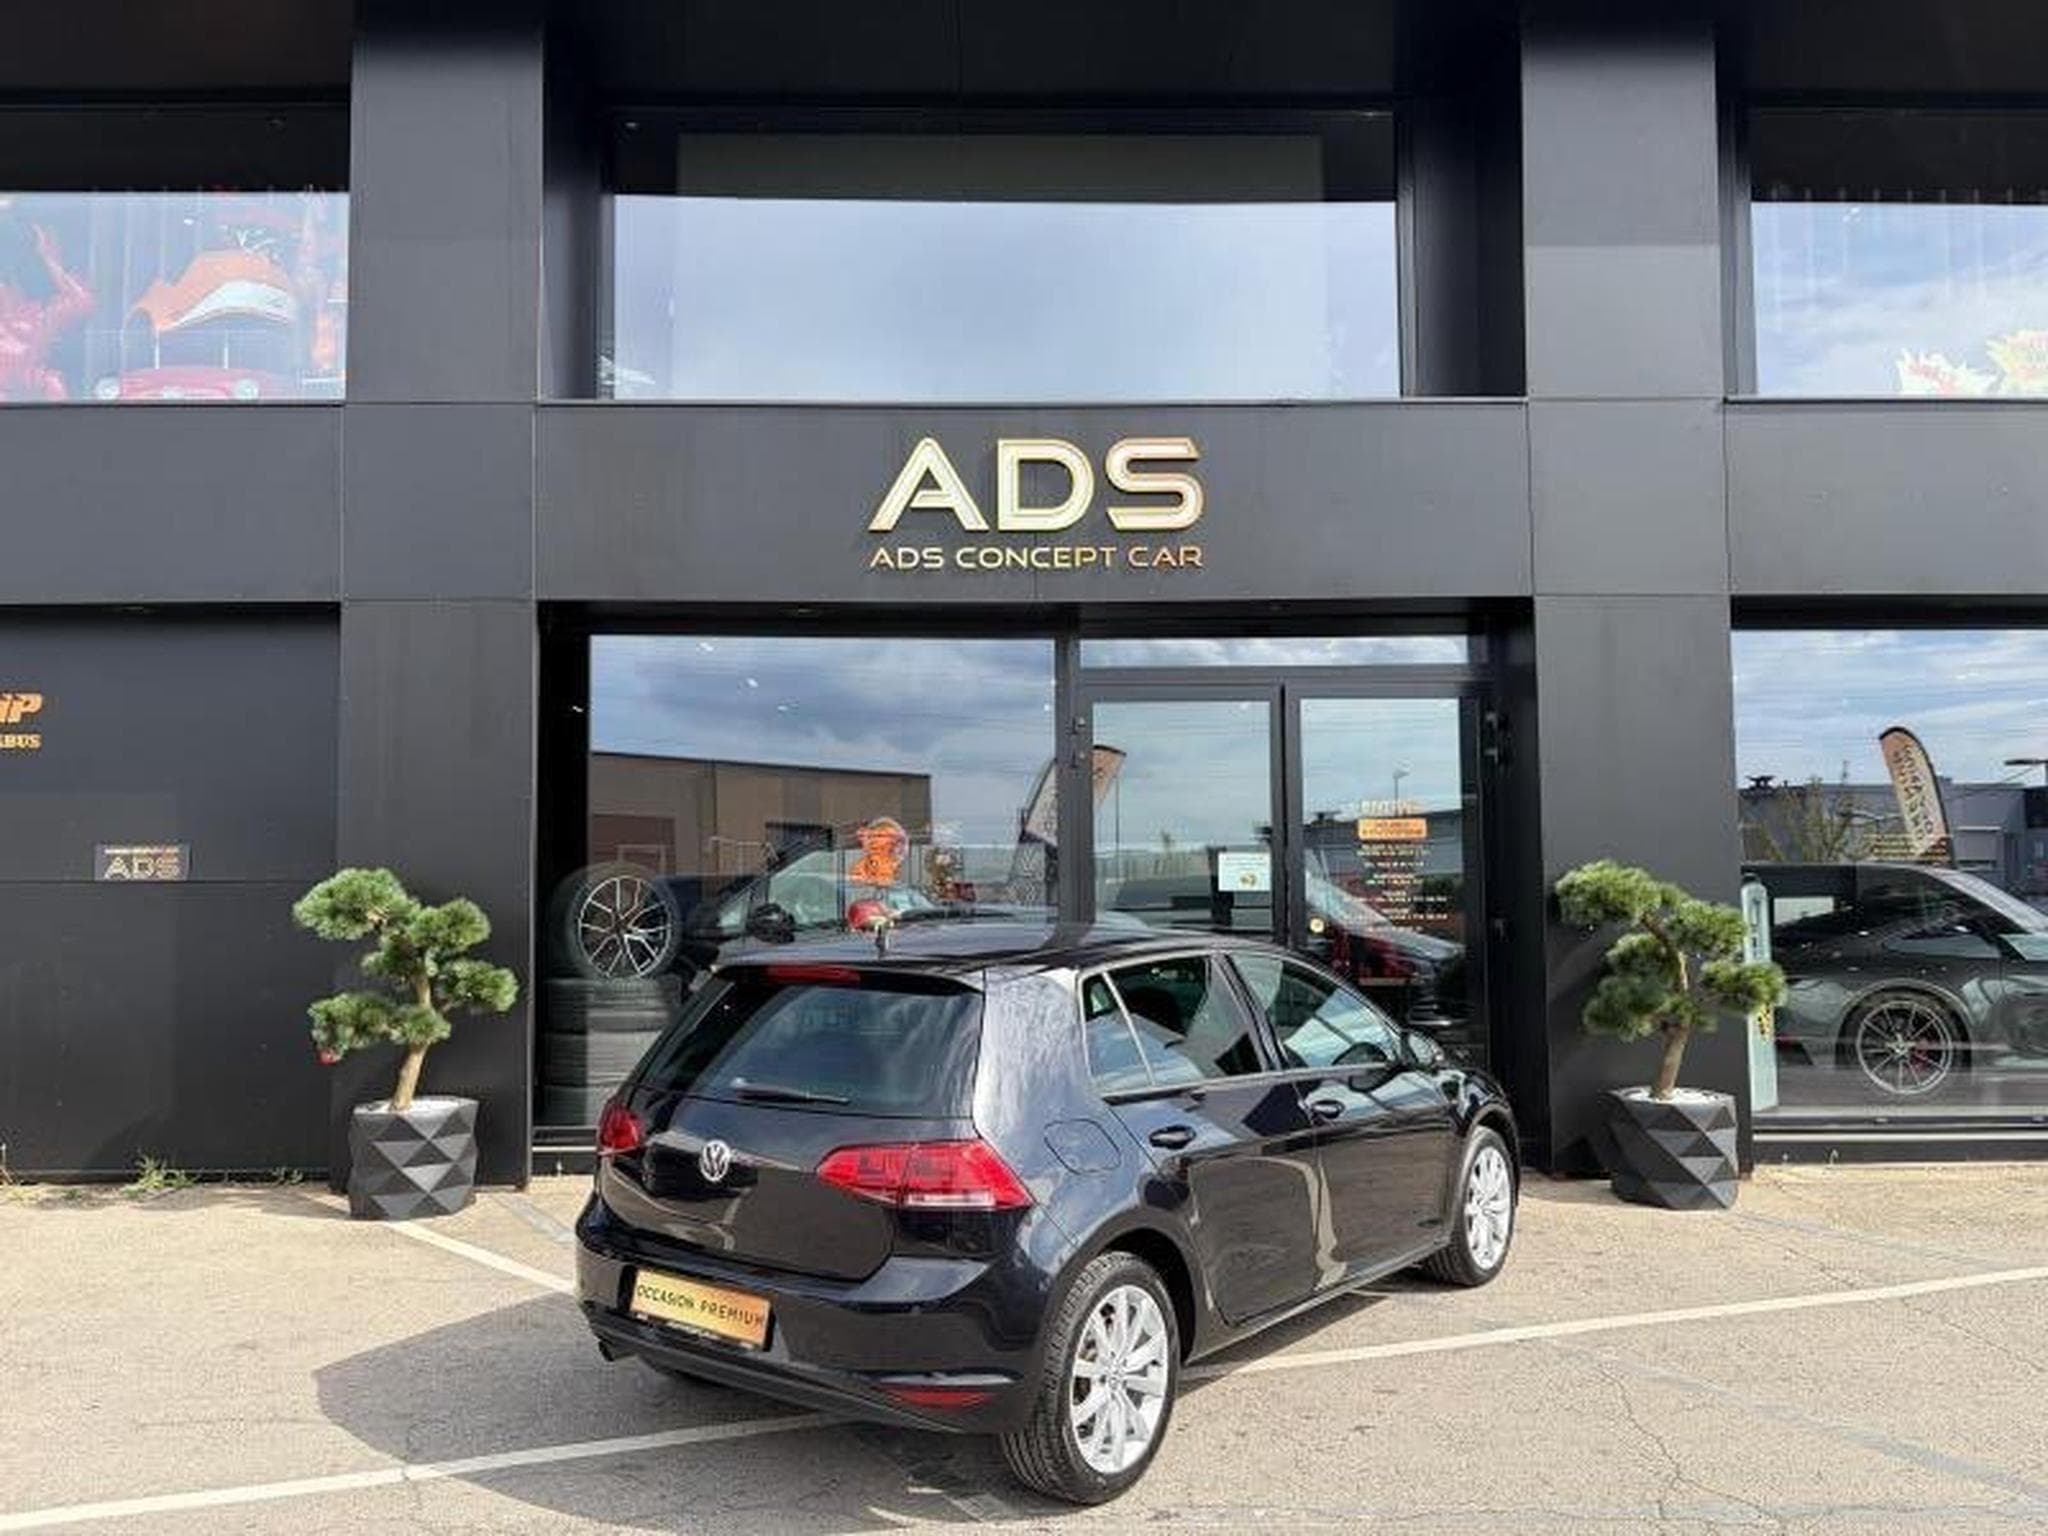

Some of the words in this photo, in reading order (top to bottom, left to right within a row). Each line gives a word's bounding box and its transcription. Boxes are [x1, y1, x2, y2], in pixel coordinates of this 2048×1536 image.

[868, 436, 1203, 532] ADS
[869, 547, 945, 569] ADS
[955, 546, 1117, 569] CONCEPT
[1127, 546, 1203, 568] CAR
[104, 856, 180, 879] ADS
[636, 1283, 695, 1309] OCCASION
[699, 1299, 765, 1326] PREMIUM
